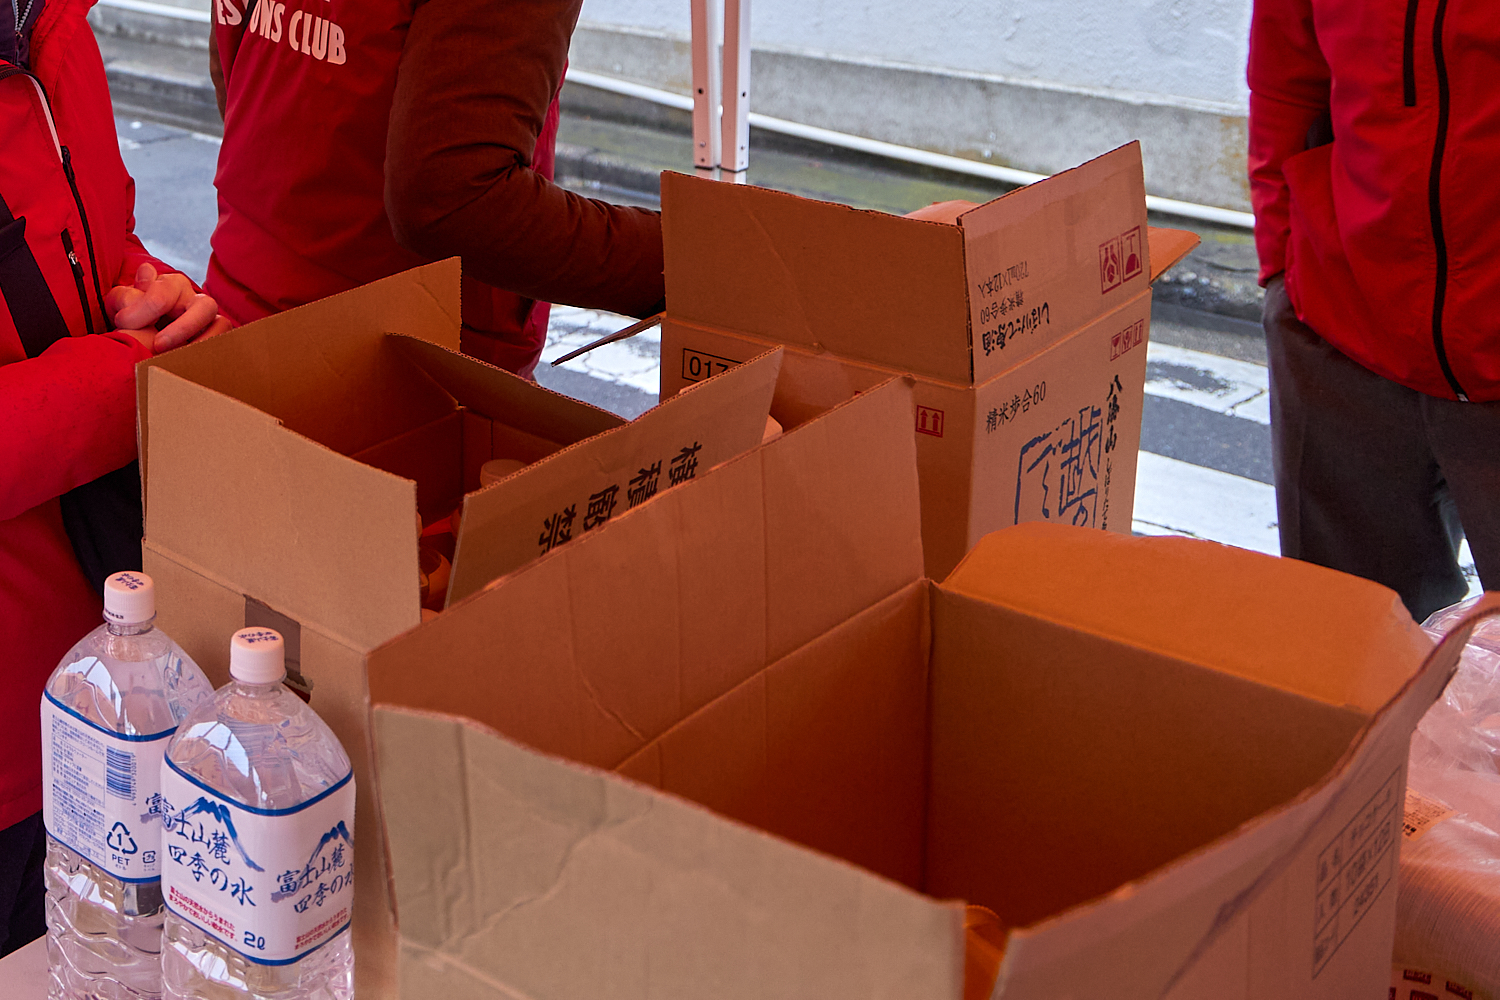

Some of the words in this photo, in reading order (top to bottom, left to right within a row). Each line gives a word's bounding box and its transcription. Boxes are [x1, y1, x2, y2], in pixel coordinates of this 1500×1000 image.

[288, 9, 347, 66] CLUB
[982, 301, 1050, 357] しぼりたて原酒
[985, 380, 1047, 434] 精米歩合60
[111, 853, 131, 866] PET
[161, 797, 231, 866] 富士山麓
[168, 843, 257, 907] 四季の水
[276, 843, 346, 894] 富士山麓
